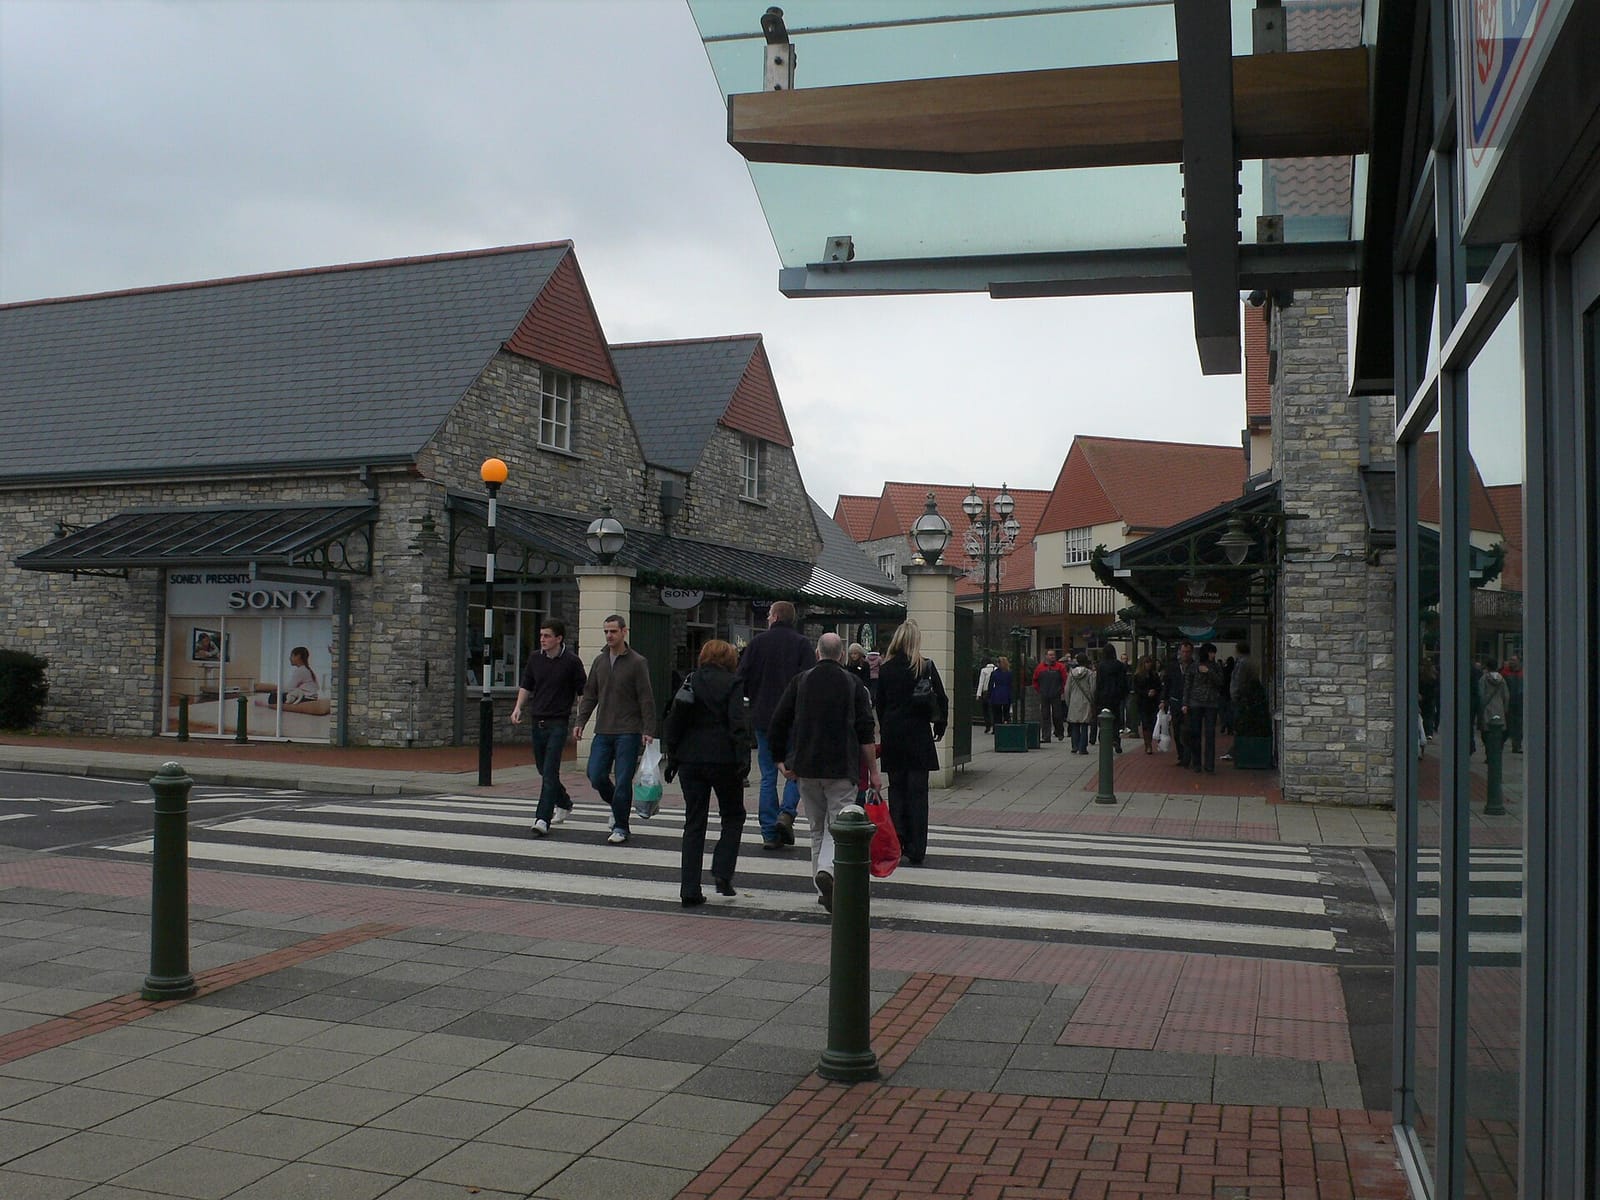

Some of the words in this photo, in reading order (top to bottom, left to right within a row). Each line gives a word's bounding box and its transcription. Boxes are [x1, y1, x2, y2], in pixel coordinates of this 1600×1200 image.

[170, 574, 202, 584] SONEX
[206, 574, 251, 584] PRESENTS
[664, 590, 700, 598] SONY
[228, 590, 321, 609] SONY
